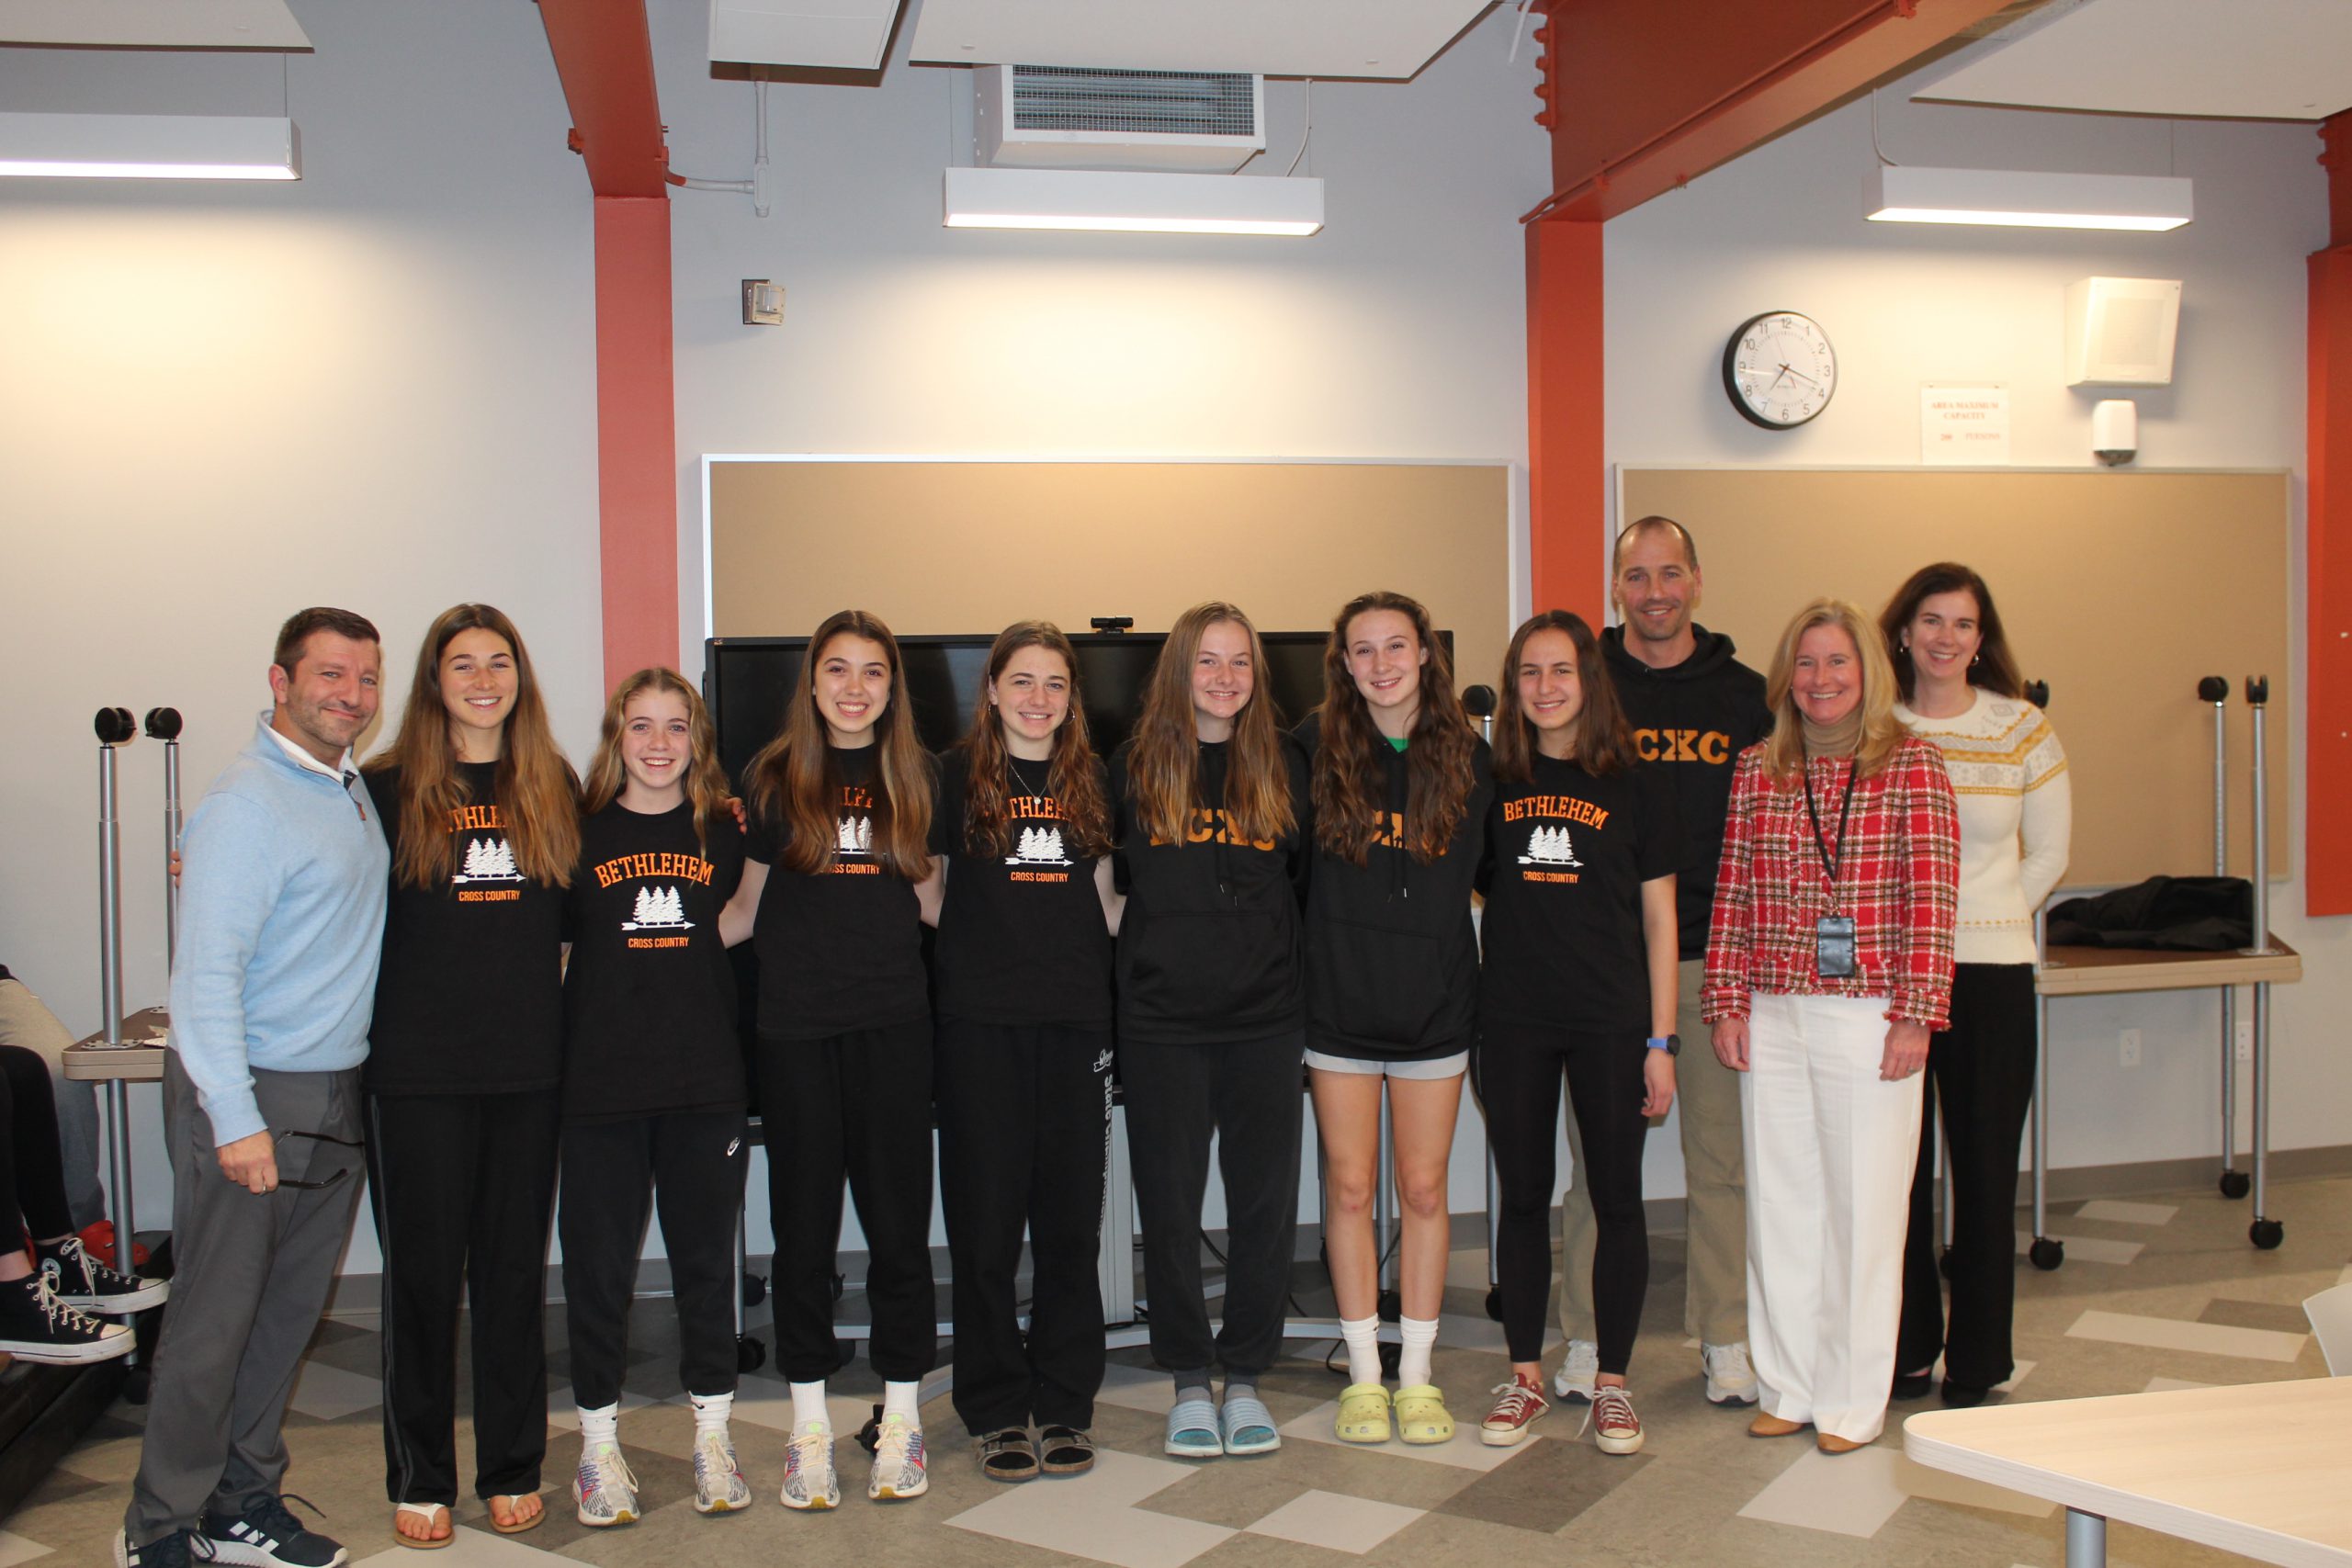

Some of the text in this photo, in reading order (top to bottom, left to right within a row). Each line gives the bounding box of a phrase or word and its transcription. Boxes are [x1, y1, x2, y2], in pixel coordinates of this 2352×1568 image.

[1759, 323, 1769, 334] 11
[1781, 317, 1792, 329] 12
[1744, 338, 1756, 351] 10
[1818, 343, 1826, 355] 2
[1739, 361, 1746, 373] 9
[1824, 366, 1831, 377] 3
[1745, 385, 1753, 397] 8
[1818, 389, 1825, 398] 4
[1761, 401, 1769, 413] 7
[1803, 404, 1810, 415] 5
[1781, 409, 1789, 421] 6
[1503, 795, 1609, 830] BETHLEHEM
[594, 852, 715, 888] BETHLEHEM
[845, 863, 880, 874] COUNTRY
[1011, 872, 1069, 883] CROSS COUNTRY
[1523, 871, 1578, 884] CROSS COUNTRY
[459, 889, 520, 902] CROSS COUNTRY
[628, 937, 689, 949] CROSS COUNTRY
